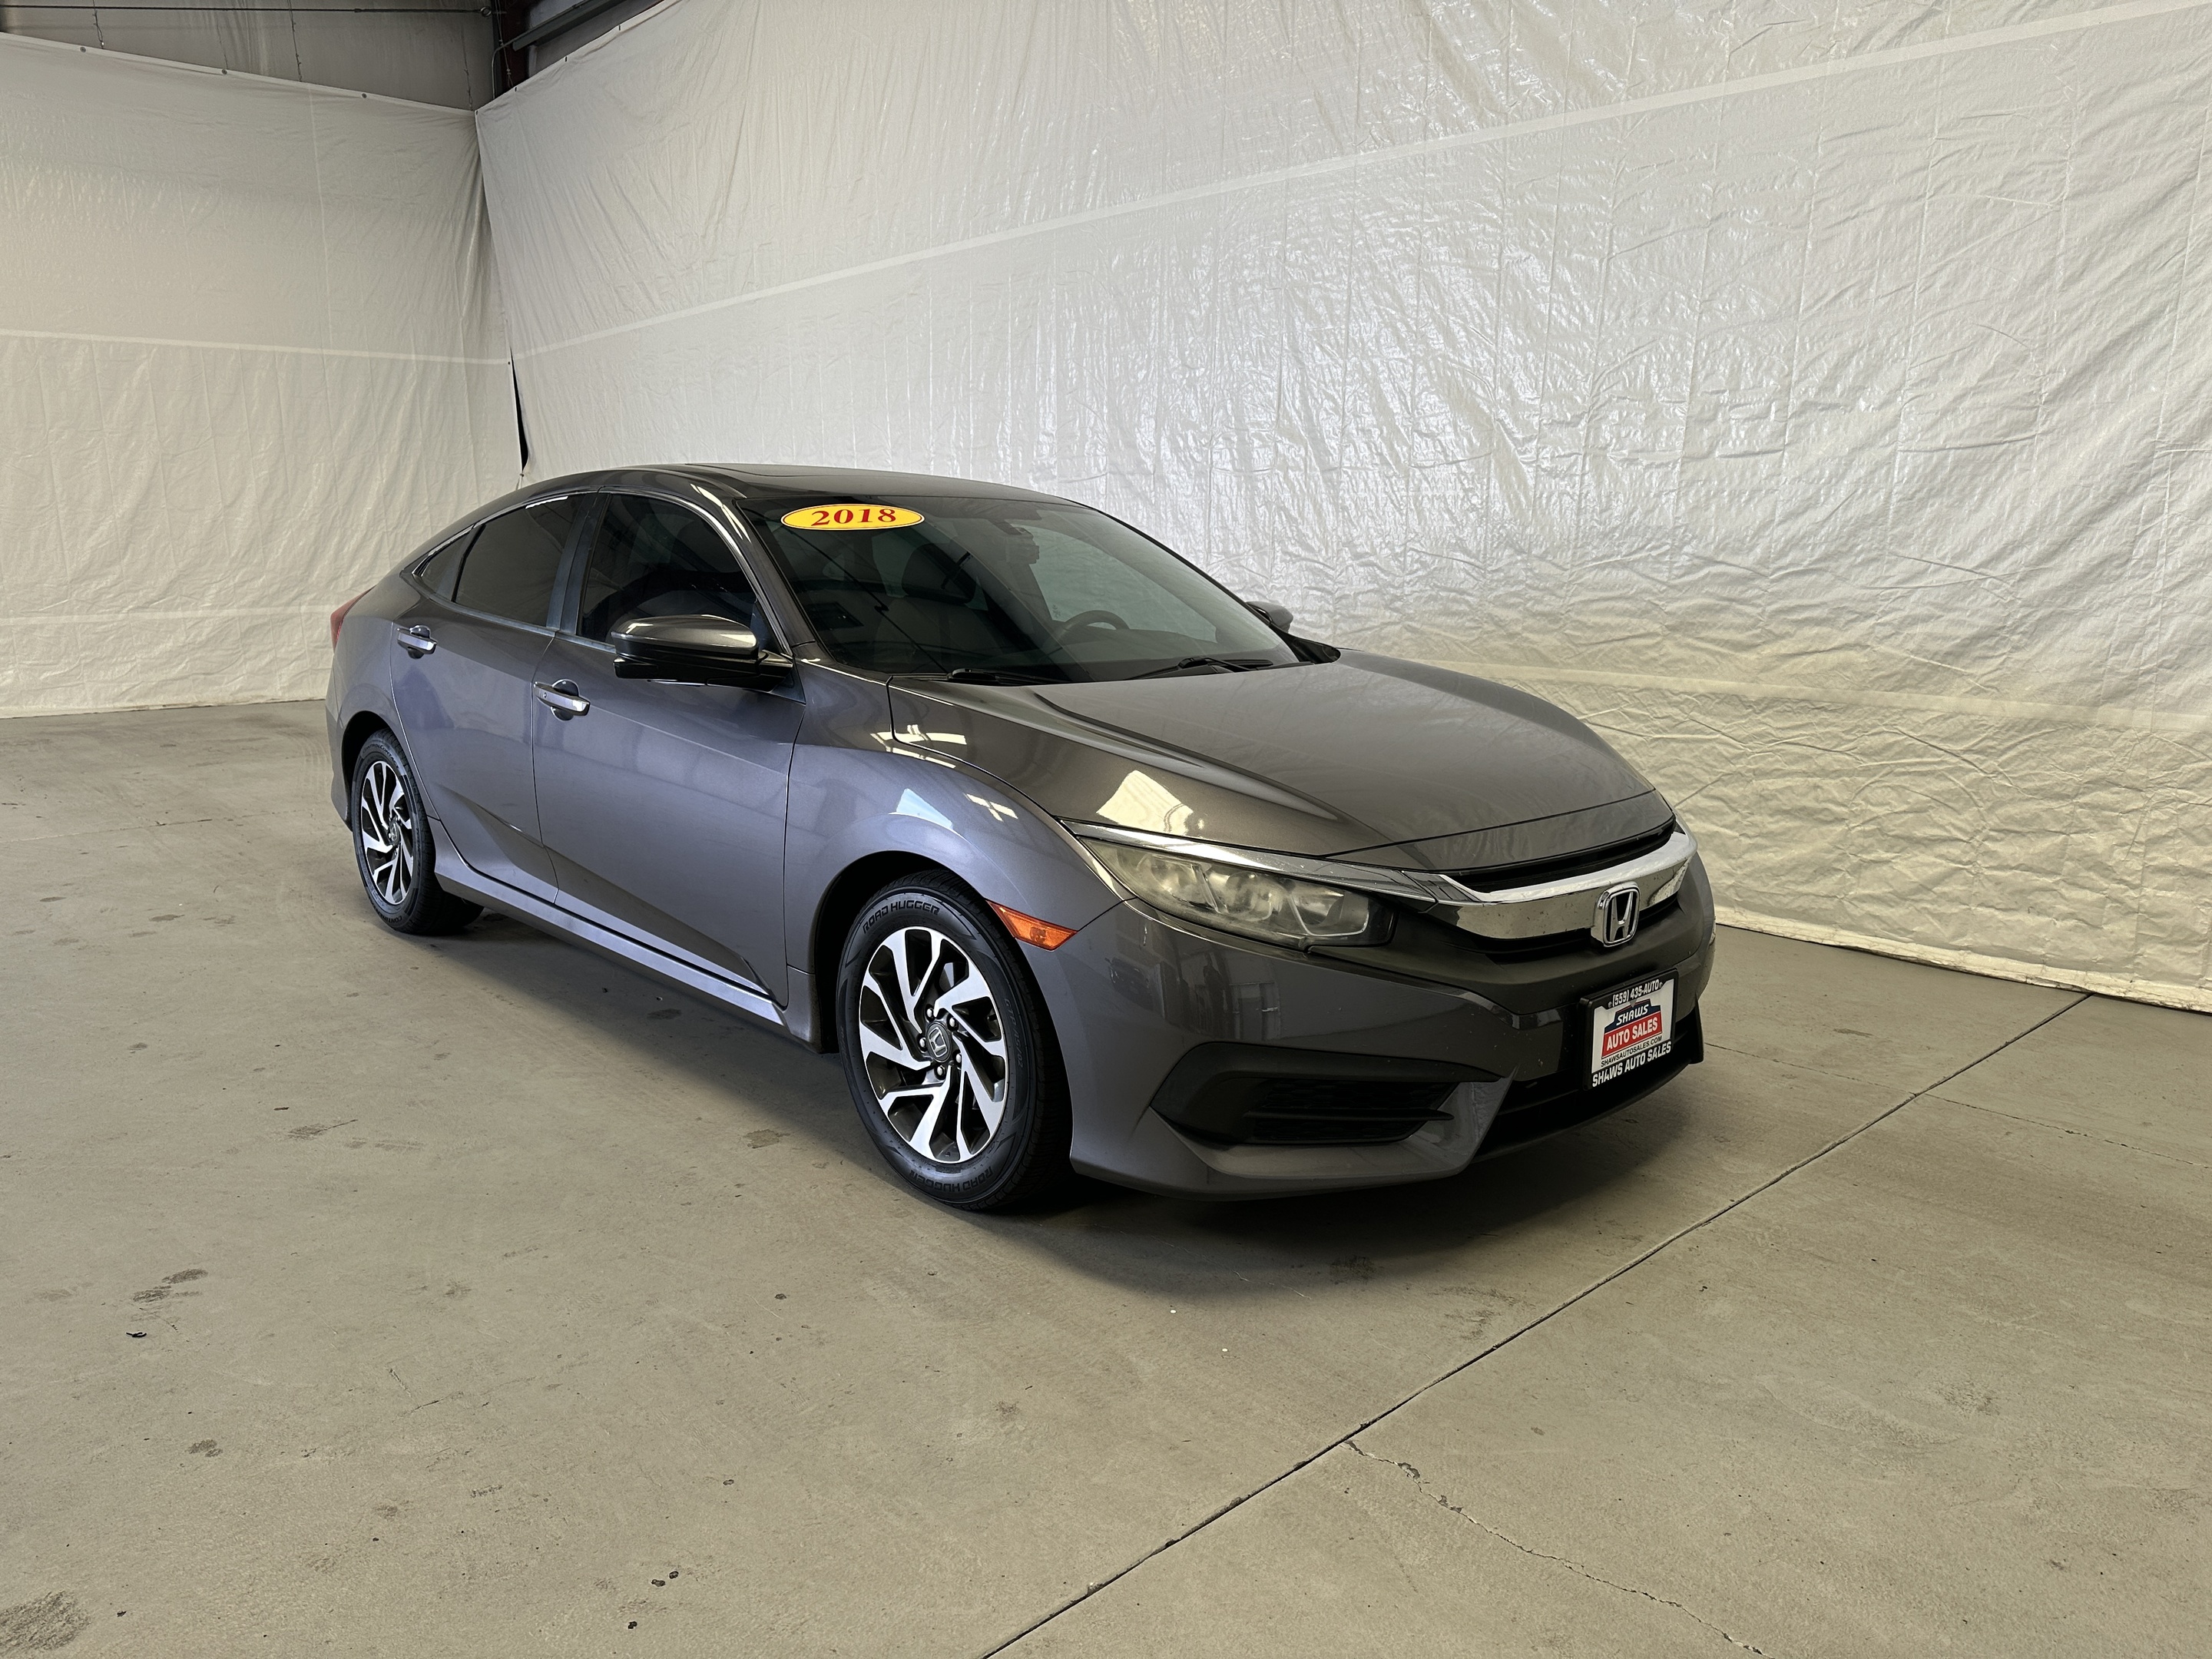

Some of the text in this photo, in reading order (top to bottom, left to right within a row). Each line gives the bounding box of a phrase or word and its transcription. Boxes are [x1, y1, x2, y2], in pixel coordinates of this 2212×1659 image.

[811, 508, 896, 527] 2018
[863, 899, 940, 934] ROAD HUGGER
[1612, 979, 1660, 1008] (559) 435-AUTO
[1616, 1004, 1649, 1026] SHAWS
[1606, 1016, 1658, 1051] AUTO SALES
[1592, 1041, 1672, 1088] SHAWS AUTO SALES
[1601, 1035, 1663, 1068] SHAWSAUTOSALES.COM
[909, 1165, 994, 1193] ROAD HUGGER
